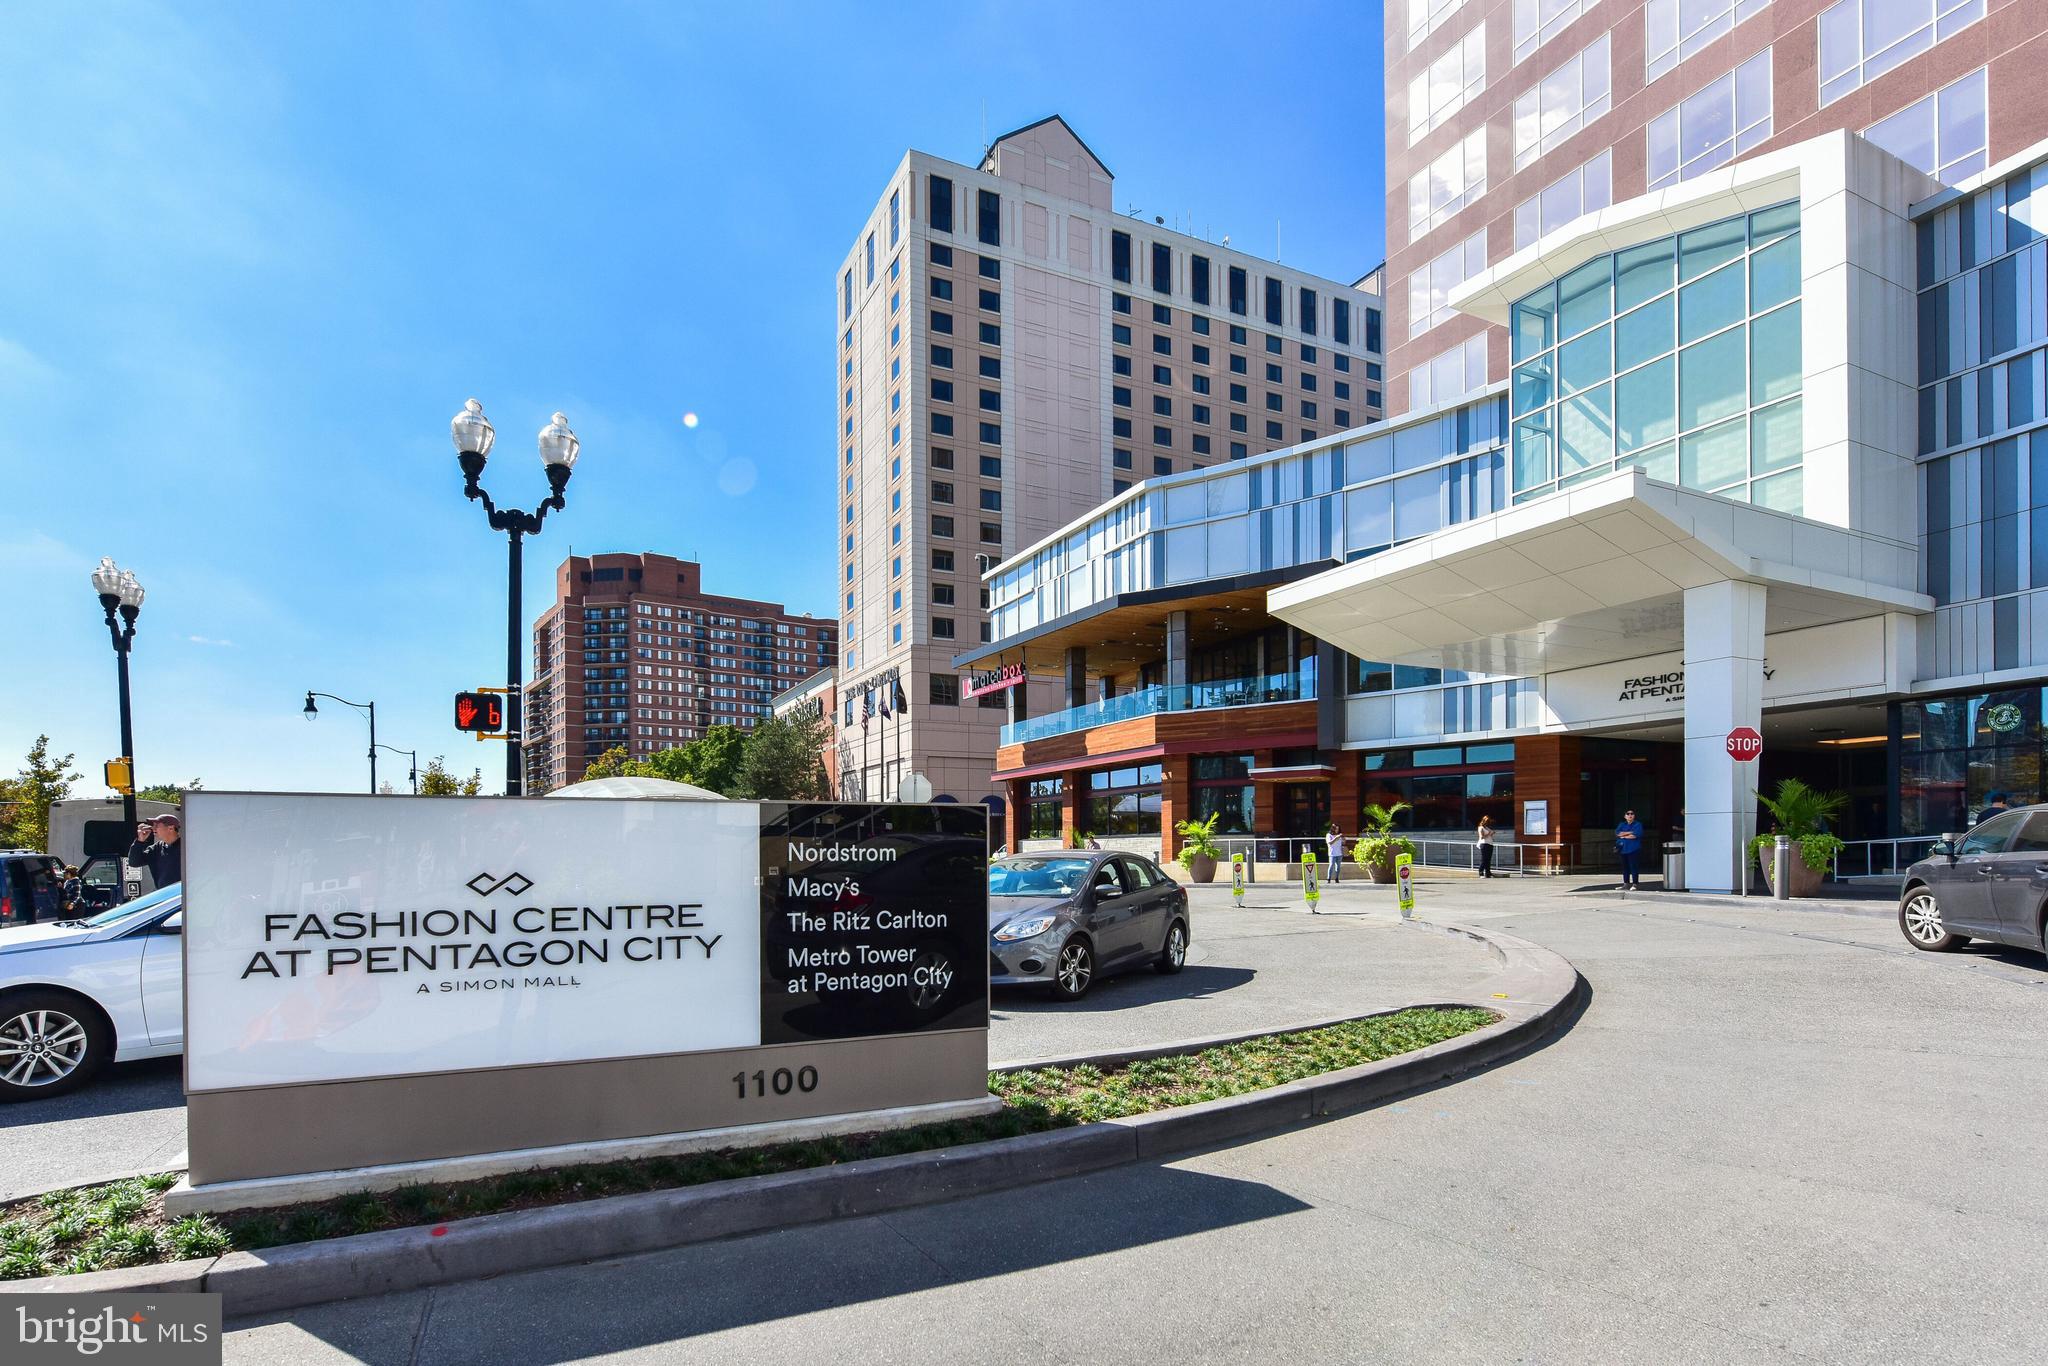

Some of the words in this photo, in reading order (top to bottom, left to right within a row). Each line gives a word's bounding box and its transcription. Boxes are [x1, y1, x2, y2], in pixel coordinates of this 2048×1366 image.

[972, 663, 1022, 689] matchbox
[1619, 690, 1637, 701] AT
[1727, 738, 1760, 751] STOP
[788, 842, 897, 862] Nordstrom
[788, 877, 860, 901] Macy's
[265, 909, 496, 941] FASHION
[513, 904, 704, 934] CENTRE
[786, 912, 827, 932] The
[833, 911, 870, 931] Ritz
[876, 909, 948, 930] Carlton
[240, 949, 311, 979] AT
[327, 938, 608, 976] PENTAGON
[623, 934, 723, 962] CITY
[788, 947, 850, 968] Metro
[856, 945, 917, 965] Tower
[416, 983, 431, 994] A
[440, 978, 515, 993] SIMON
[524, 975, 582, 988] MALL
[787, 975, 808, 993] at
[815, 970, 908, 993] Pentagon
[913, 966, 953, 988] City
[732, 1065, 819, 1099] 1100
